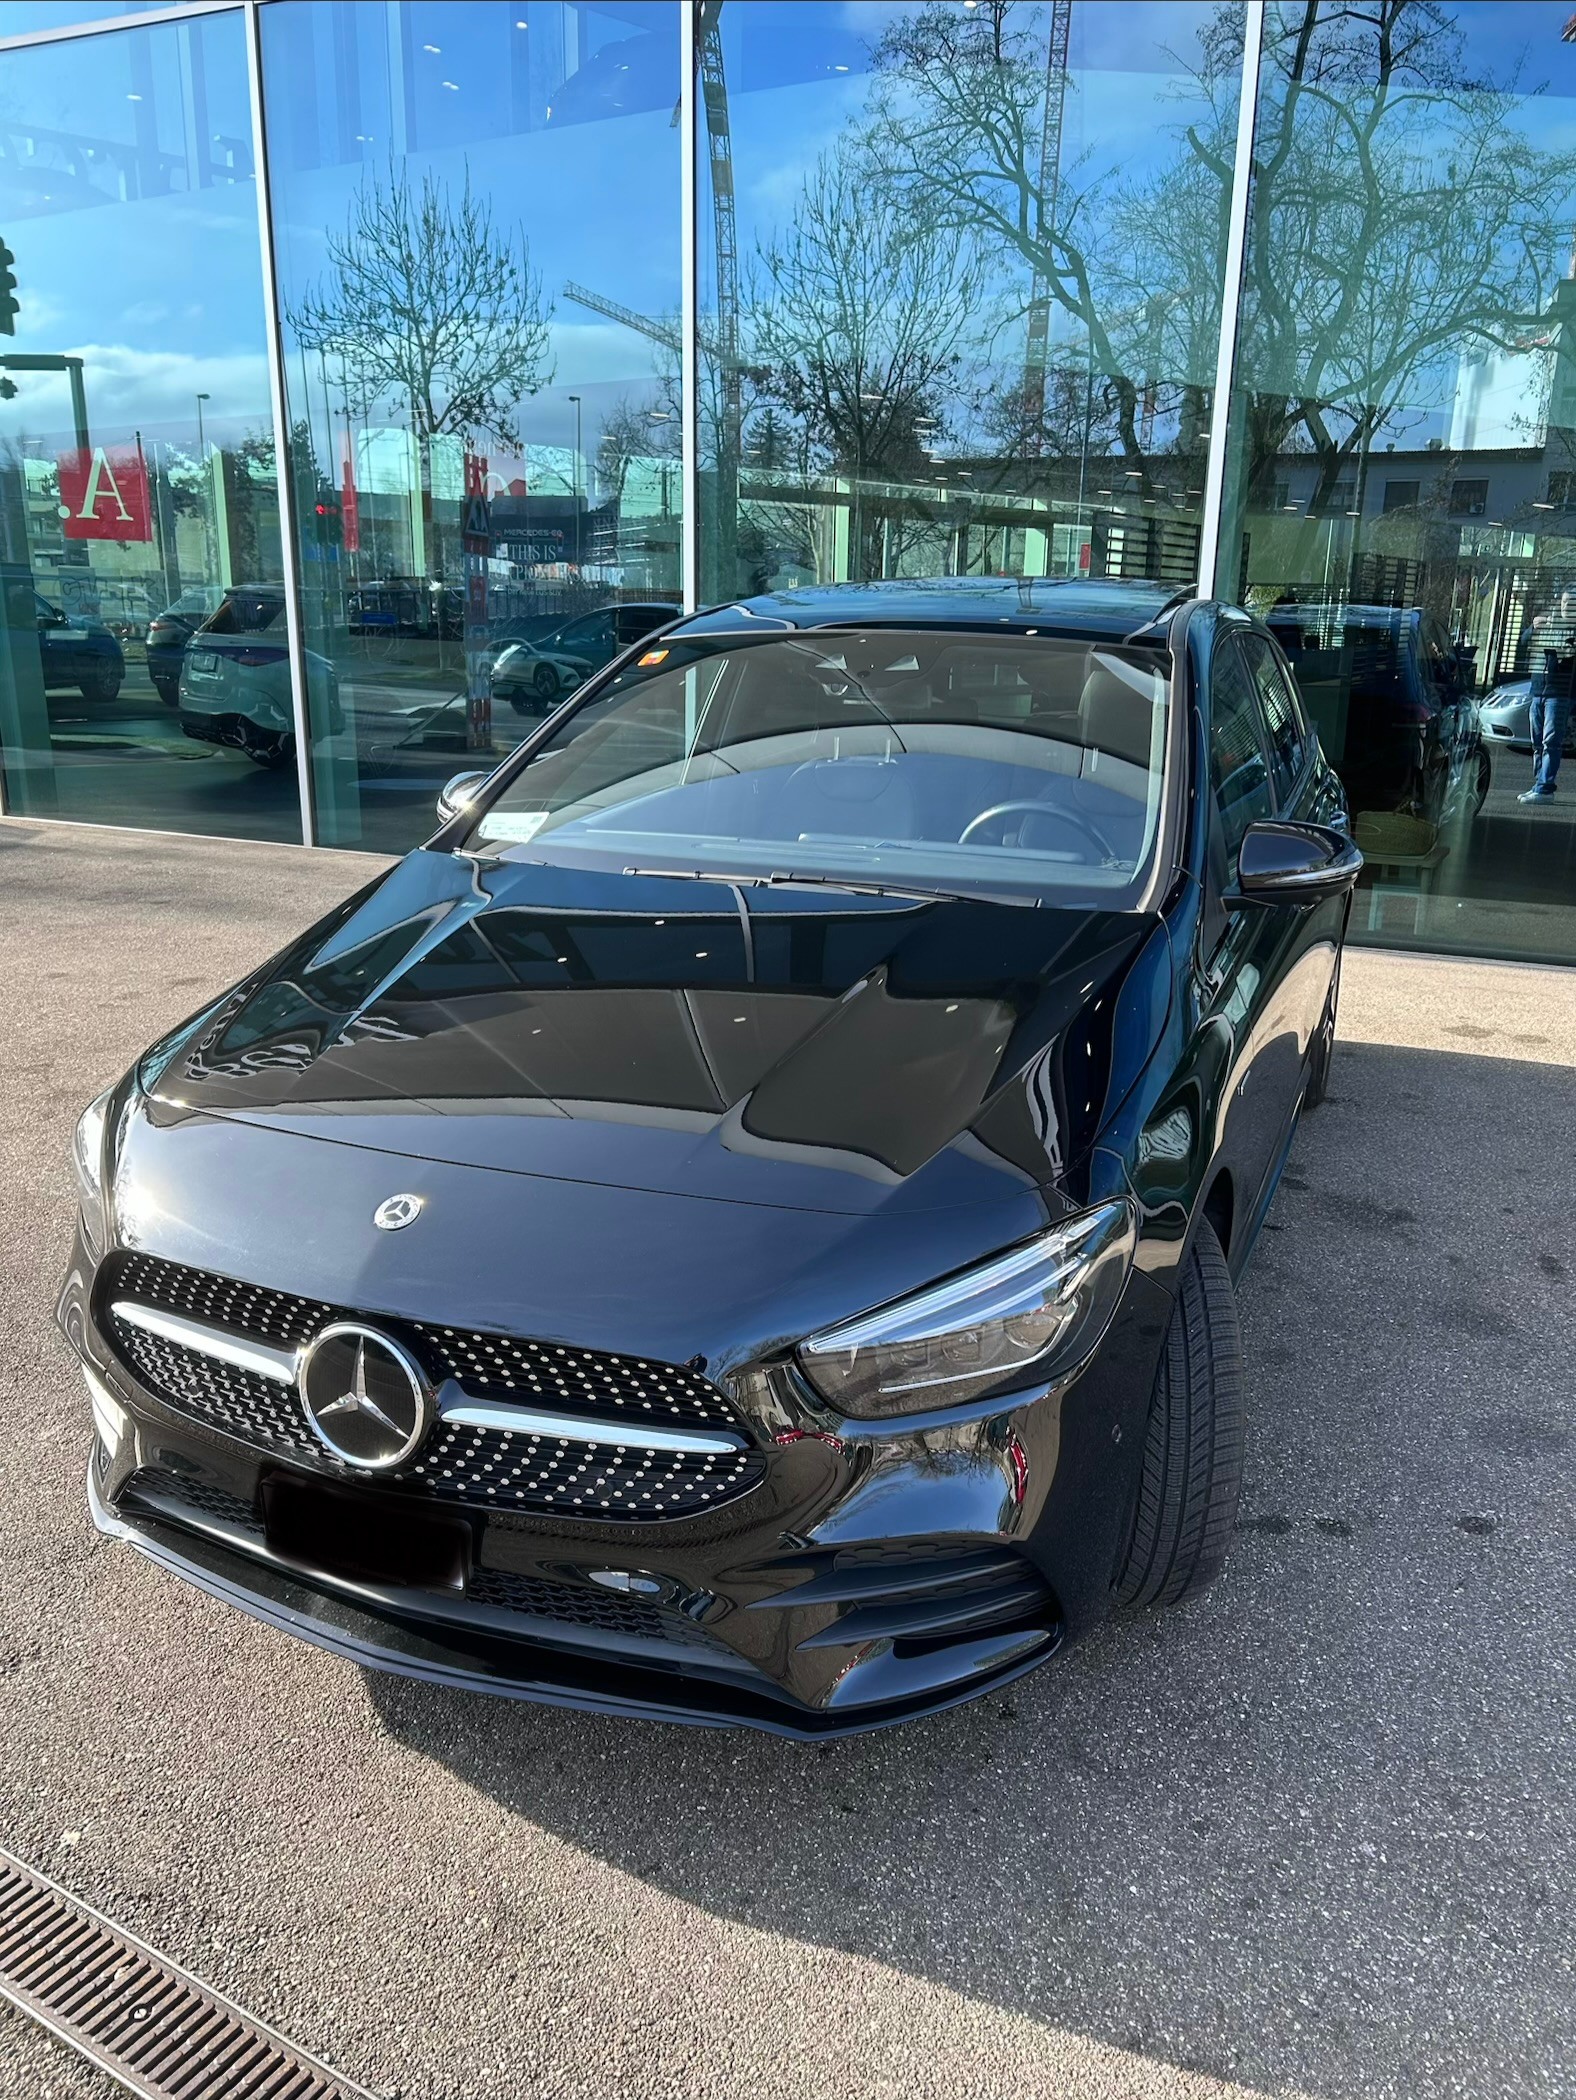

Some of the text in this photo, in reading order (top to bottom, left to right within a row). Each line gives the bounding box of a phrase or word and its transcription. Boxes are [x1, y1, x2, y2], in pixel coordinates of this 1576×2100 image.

[503, 528, 563, 537] MERCEDES-EQ
[509, 544, 557, 561] THIS IS
